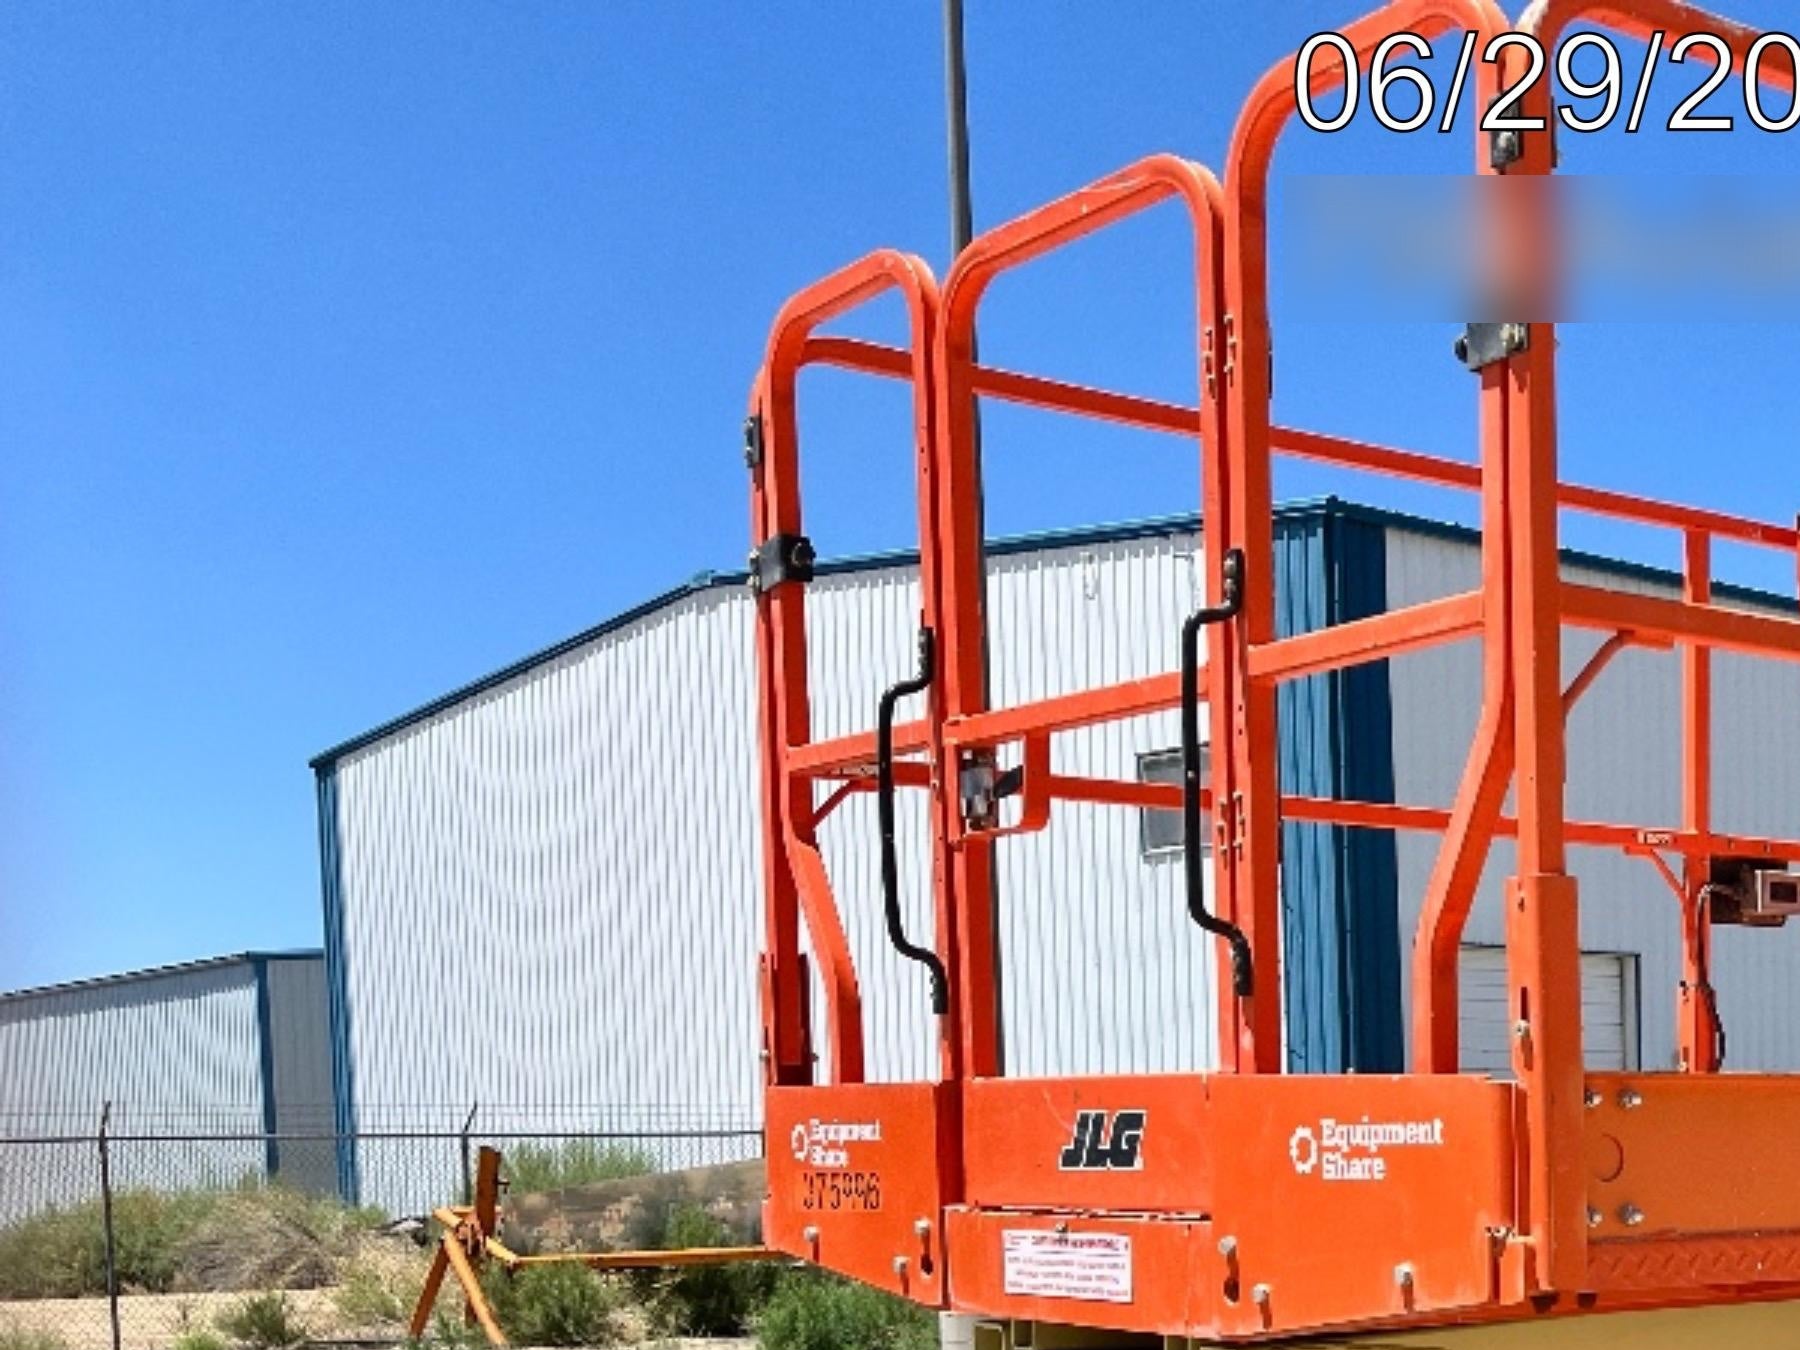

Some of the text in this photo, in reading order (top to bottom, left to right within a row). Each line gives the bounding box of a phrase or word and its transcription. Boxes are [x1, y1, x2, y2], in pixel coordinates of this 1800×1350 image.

[808, 1118, 882, 1146] Equipment
[1058, 1109, 1147, 1171] JLG
[1319, 1115, 1444, 1153] Equipment
[1322, 1151, 1387, 1180] Share
